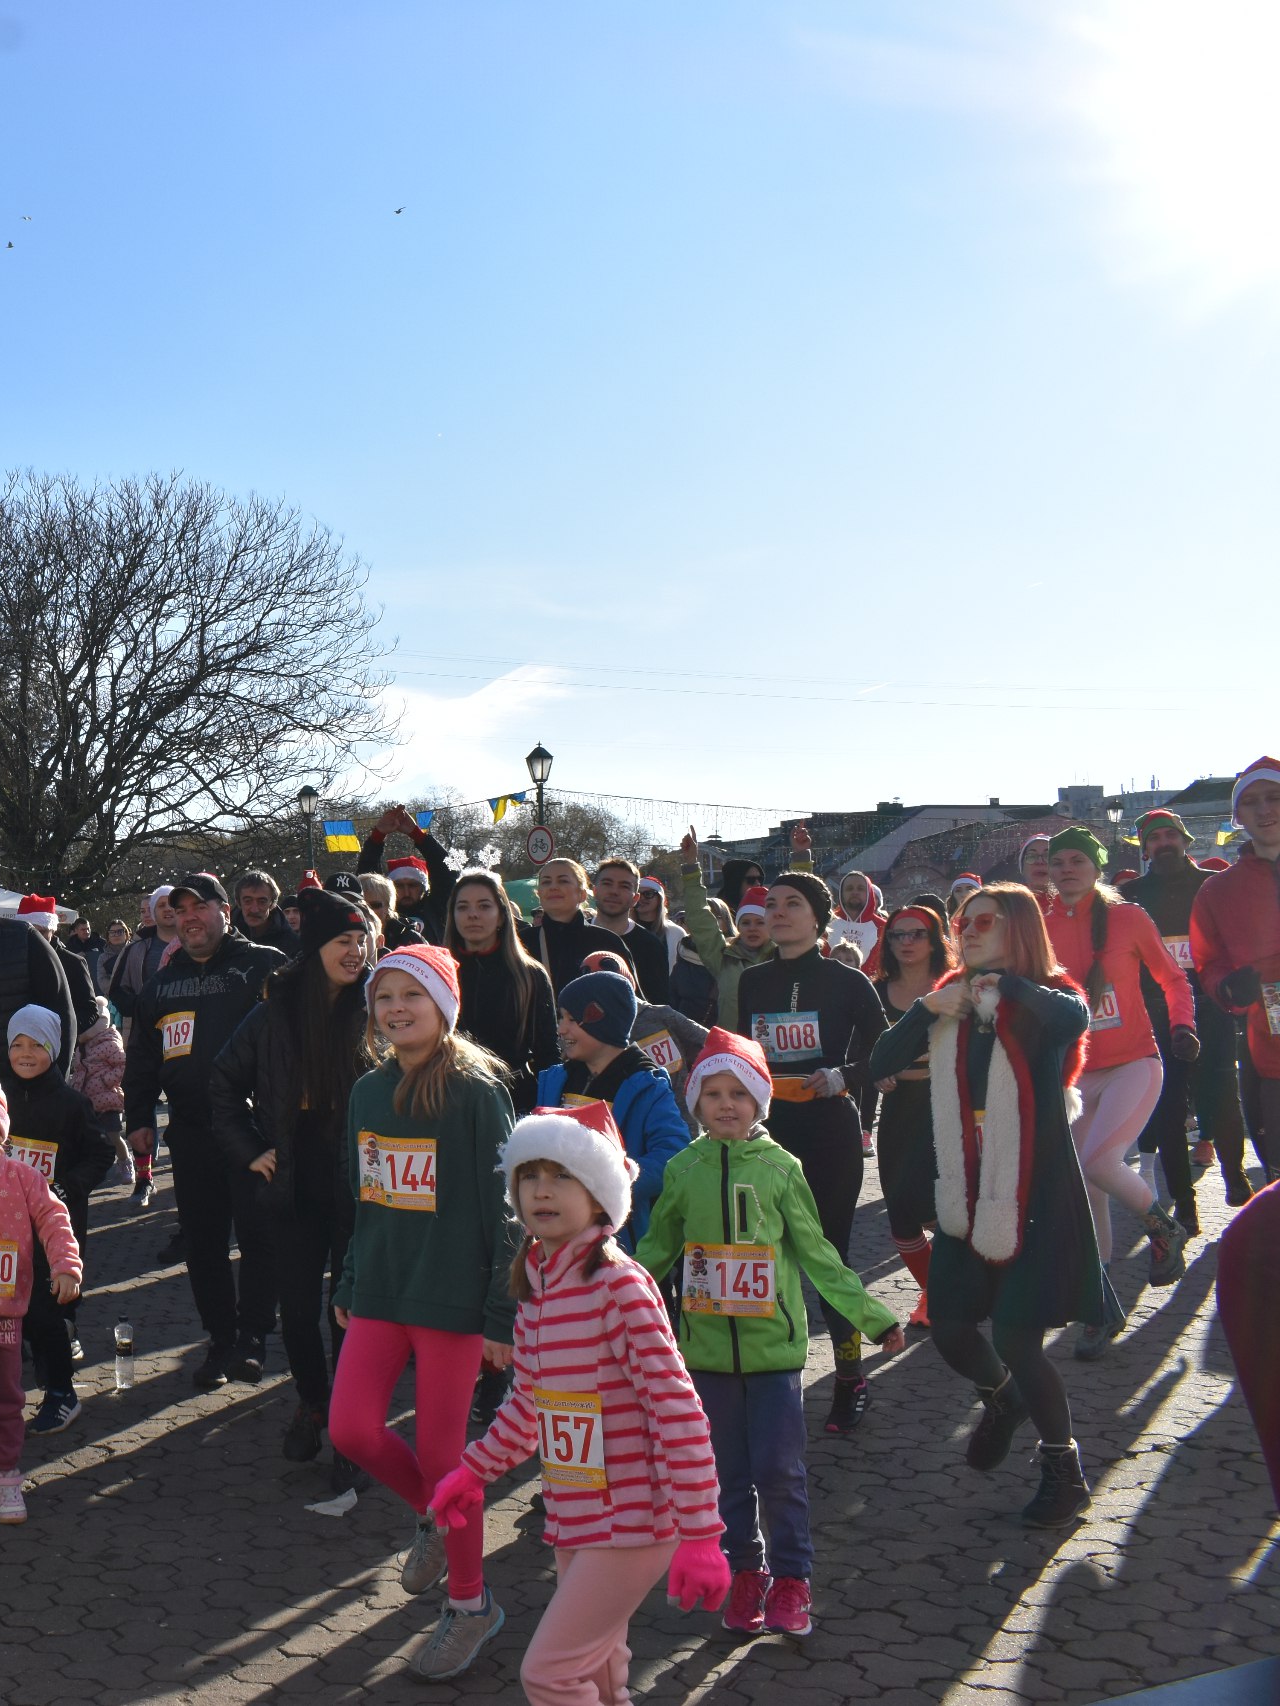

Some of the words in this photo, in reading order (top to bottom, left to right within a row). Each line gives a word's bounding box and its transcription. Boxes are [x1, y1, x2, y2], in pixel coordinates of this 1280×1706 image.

[336, 875, 350, 888] NY
[166, 1021, 191, 1048] 169
[775, 1023, 817, 1051] 008
[17, 1149, 53, 1177] 175
[385, 1154, 436, 1192] 144
[715, 1262, 769, 1299] 145
[537, 1411, 595, 1464] 157
